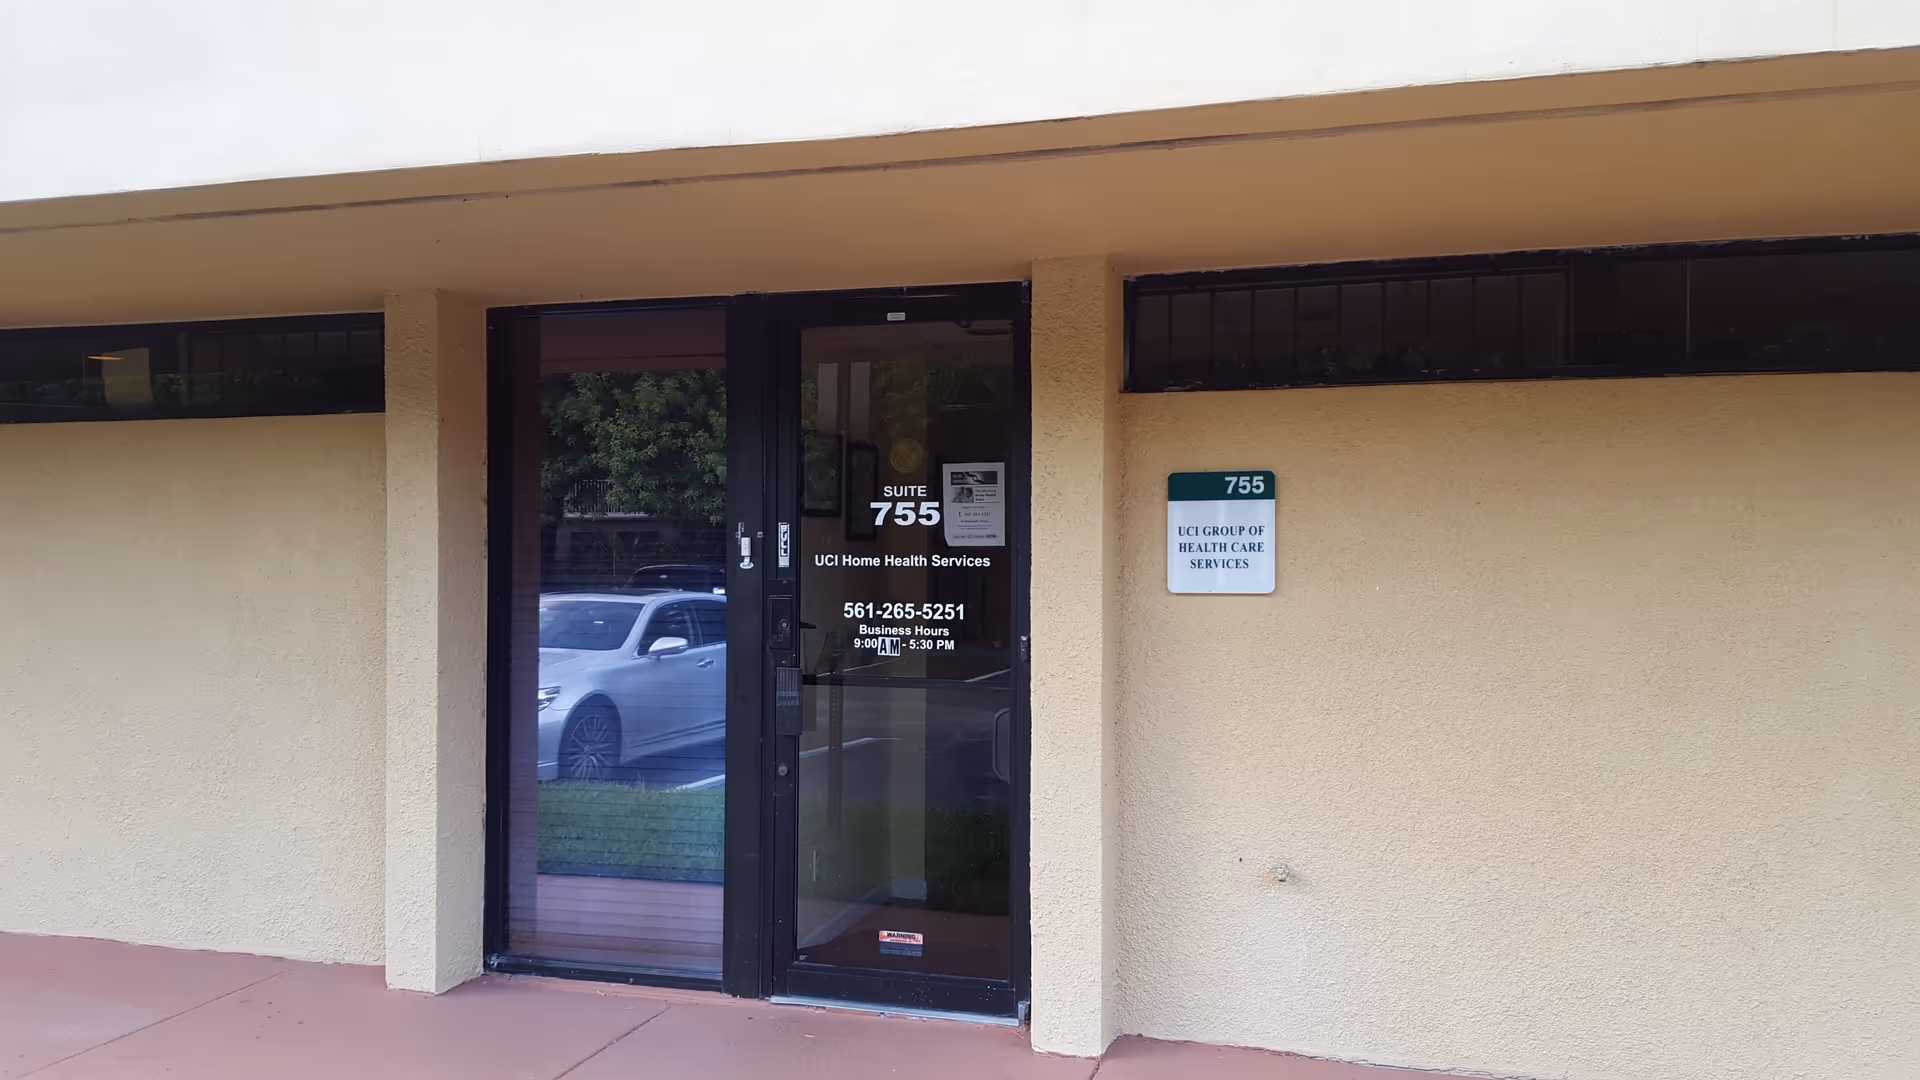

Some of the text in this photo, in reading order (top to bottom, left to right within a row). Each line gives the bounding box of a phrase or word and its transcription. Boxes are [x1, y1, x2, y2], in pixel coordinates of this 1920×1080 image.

[883, 485, 927, 497] SUITE
[1225, 475, 1265, 495] 755
[870, 501, 941, 526] 755
[1178, 525, 1266, 536] UCI GROUP OF
[780, 525, 788, 557] PULL
[1178, 542, 1265, 553] HEALTH CARE
[815, 554, 991, 567] UCI Home Health Services
[1190, 558, 1250, 569] SERVICES
[843, 602, 965, 620] 561-265-5251
[859, 624, 950, 636] Business Hours
[853, 638, 878, 649] 9:00
[878, 637, 900, 656] AM
[909, 639, 934, 650] 5:30
[936, 640, 955, 650] PM
[886, 932, 916, 940] WARNING
